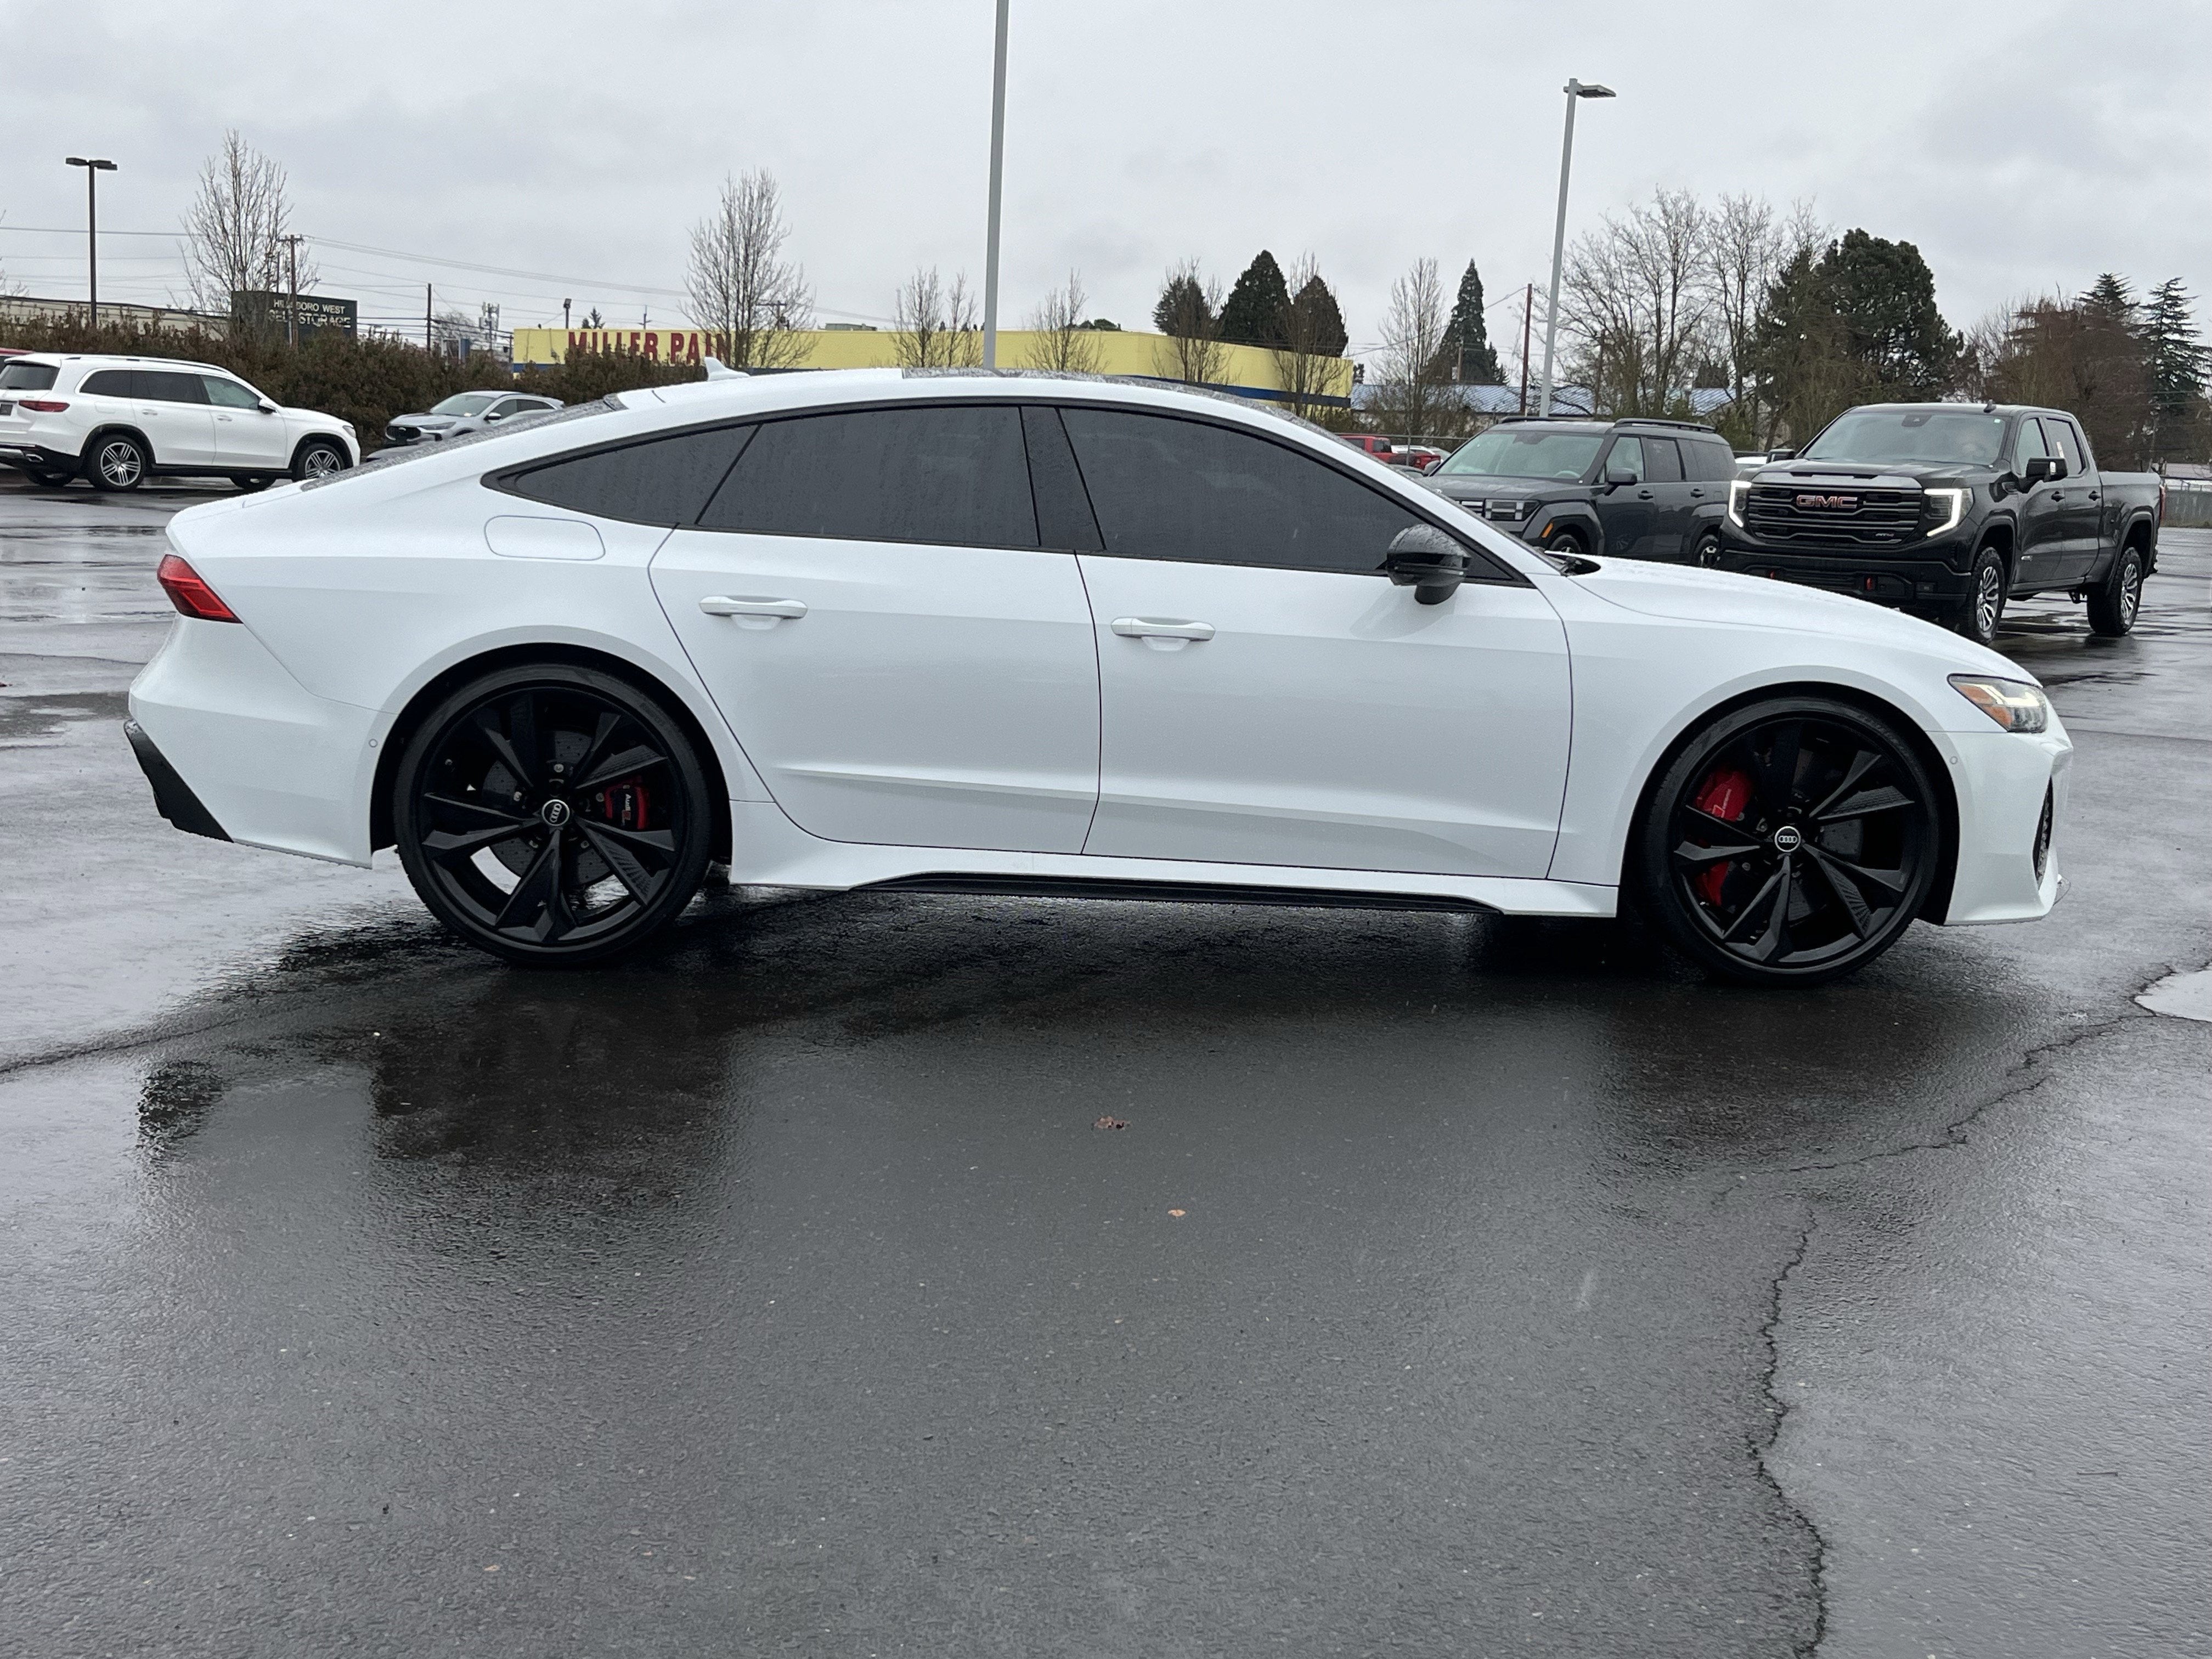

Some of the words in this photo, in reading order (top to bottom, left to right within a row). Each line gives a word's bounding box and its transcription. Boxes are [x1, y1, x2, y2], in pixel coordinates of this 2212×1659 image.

[322, 304, 345, 314] WEST
[670, 332, 748, 366] PAIN
[1796, 494, 1858, 509] GMC
